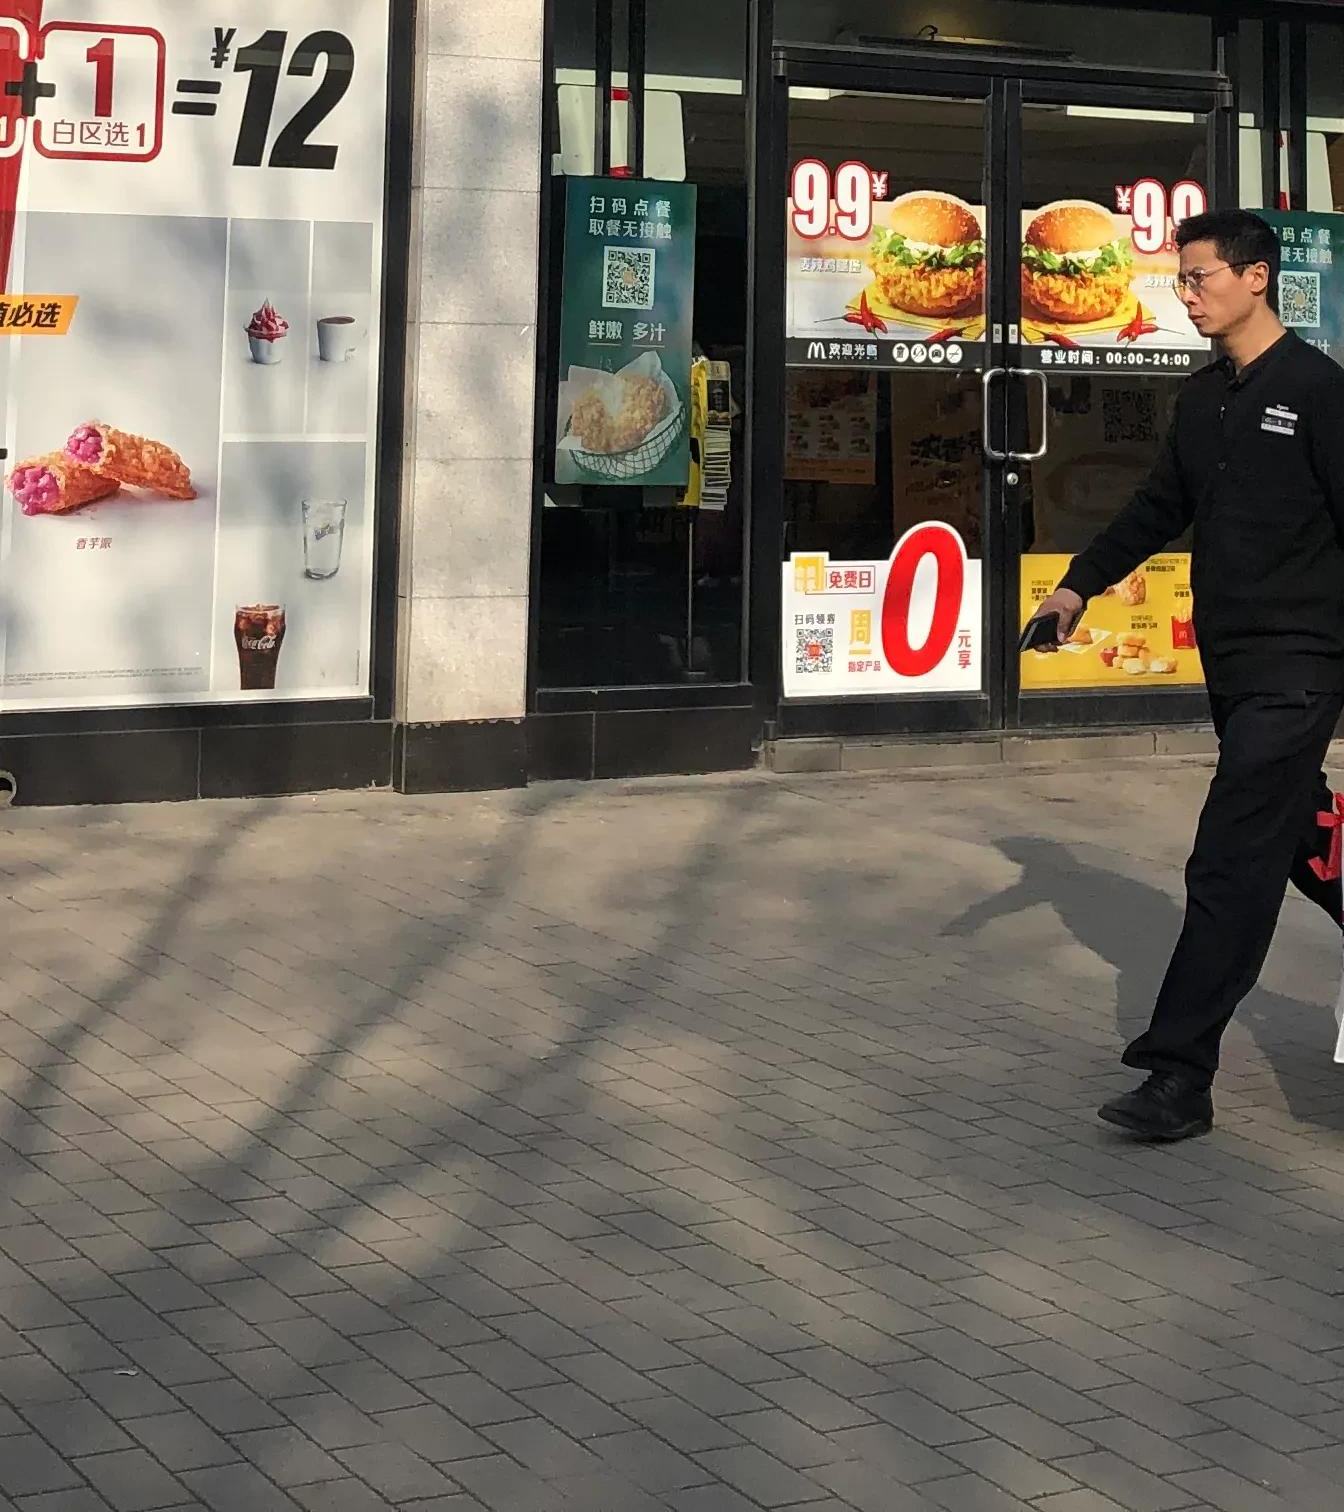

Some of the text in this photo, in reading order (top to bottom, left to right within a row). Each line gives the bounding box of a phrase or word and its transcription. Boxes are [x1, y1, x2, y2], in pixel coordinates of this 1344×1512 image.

[589, 195, 671, 218] 扫码点餐
[588, 218, 672, 240] 取餐无接触
[1270, 226, 1331, 245] 码点餐
[1280, 246, 1333, 265] 餐无接触
[588, 319, 666, 342] 鲜嫩 多汁
[829, 570, 872, 589] 免费日
[881, 526, 964, 677] 0
